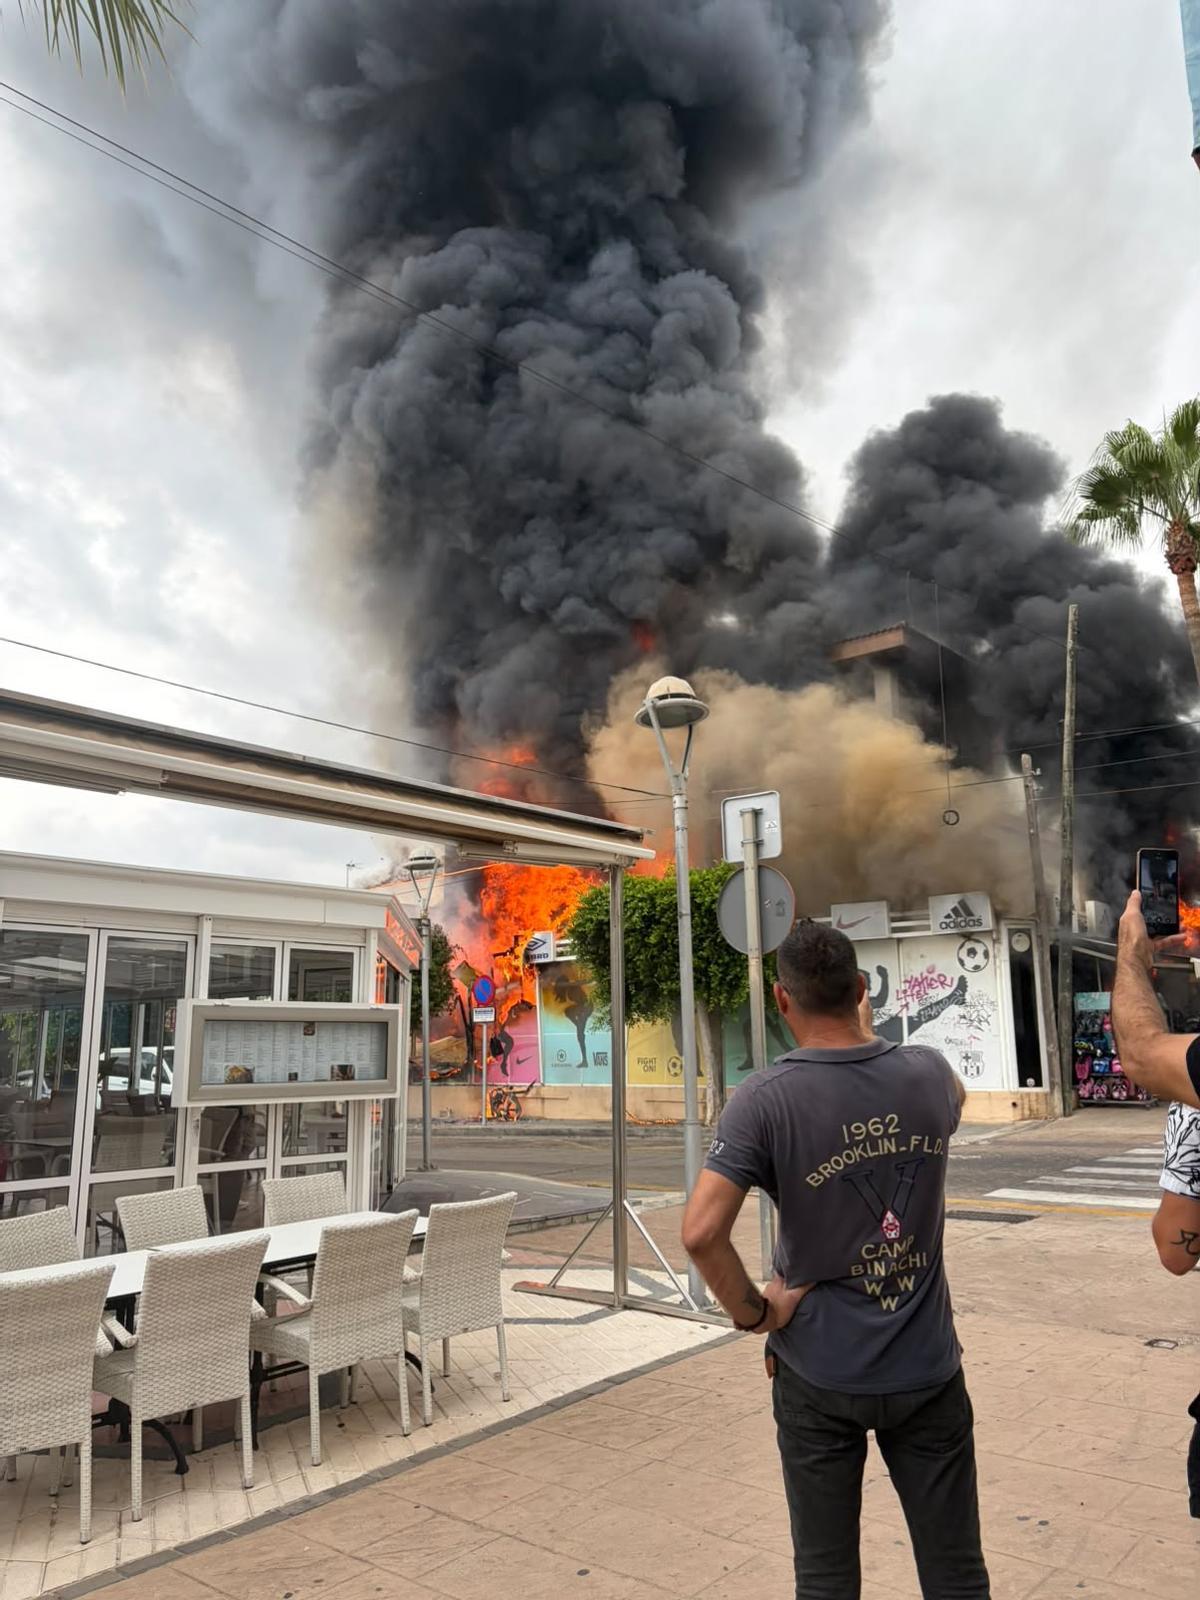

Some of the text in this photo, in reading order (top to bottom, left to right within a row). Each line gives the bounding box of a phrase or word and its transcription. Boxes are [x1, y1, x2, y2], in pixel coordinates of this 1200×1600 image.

[939, 916, 983, 930] adidas
[592, 1051, 608, 1067] VANS
[637, 1057, 657, 1065] FIGHT
[842, 1113, 901, 1144] 1962
[861, 1235, 915, 1260] CAMP
[864, 1275, 915, 1295] W W
[880, 1295, 900, 1312] W
